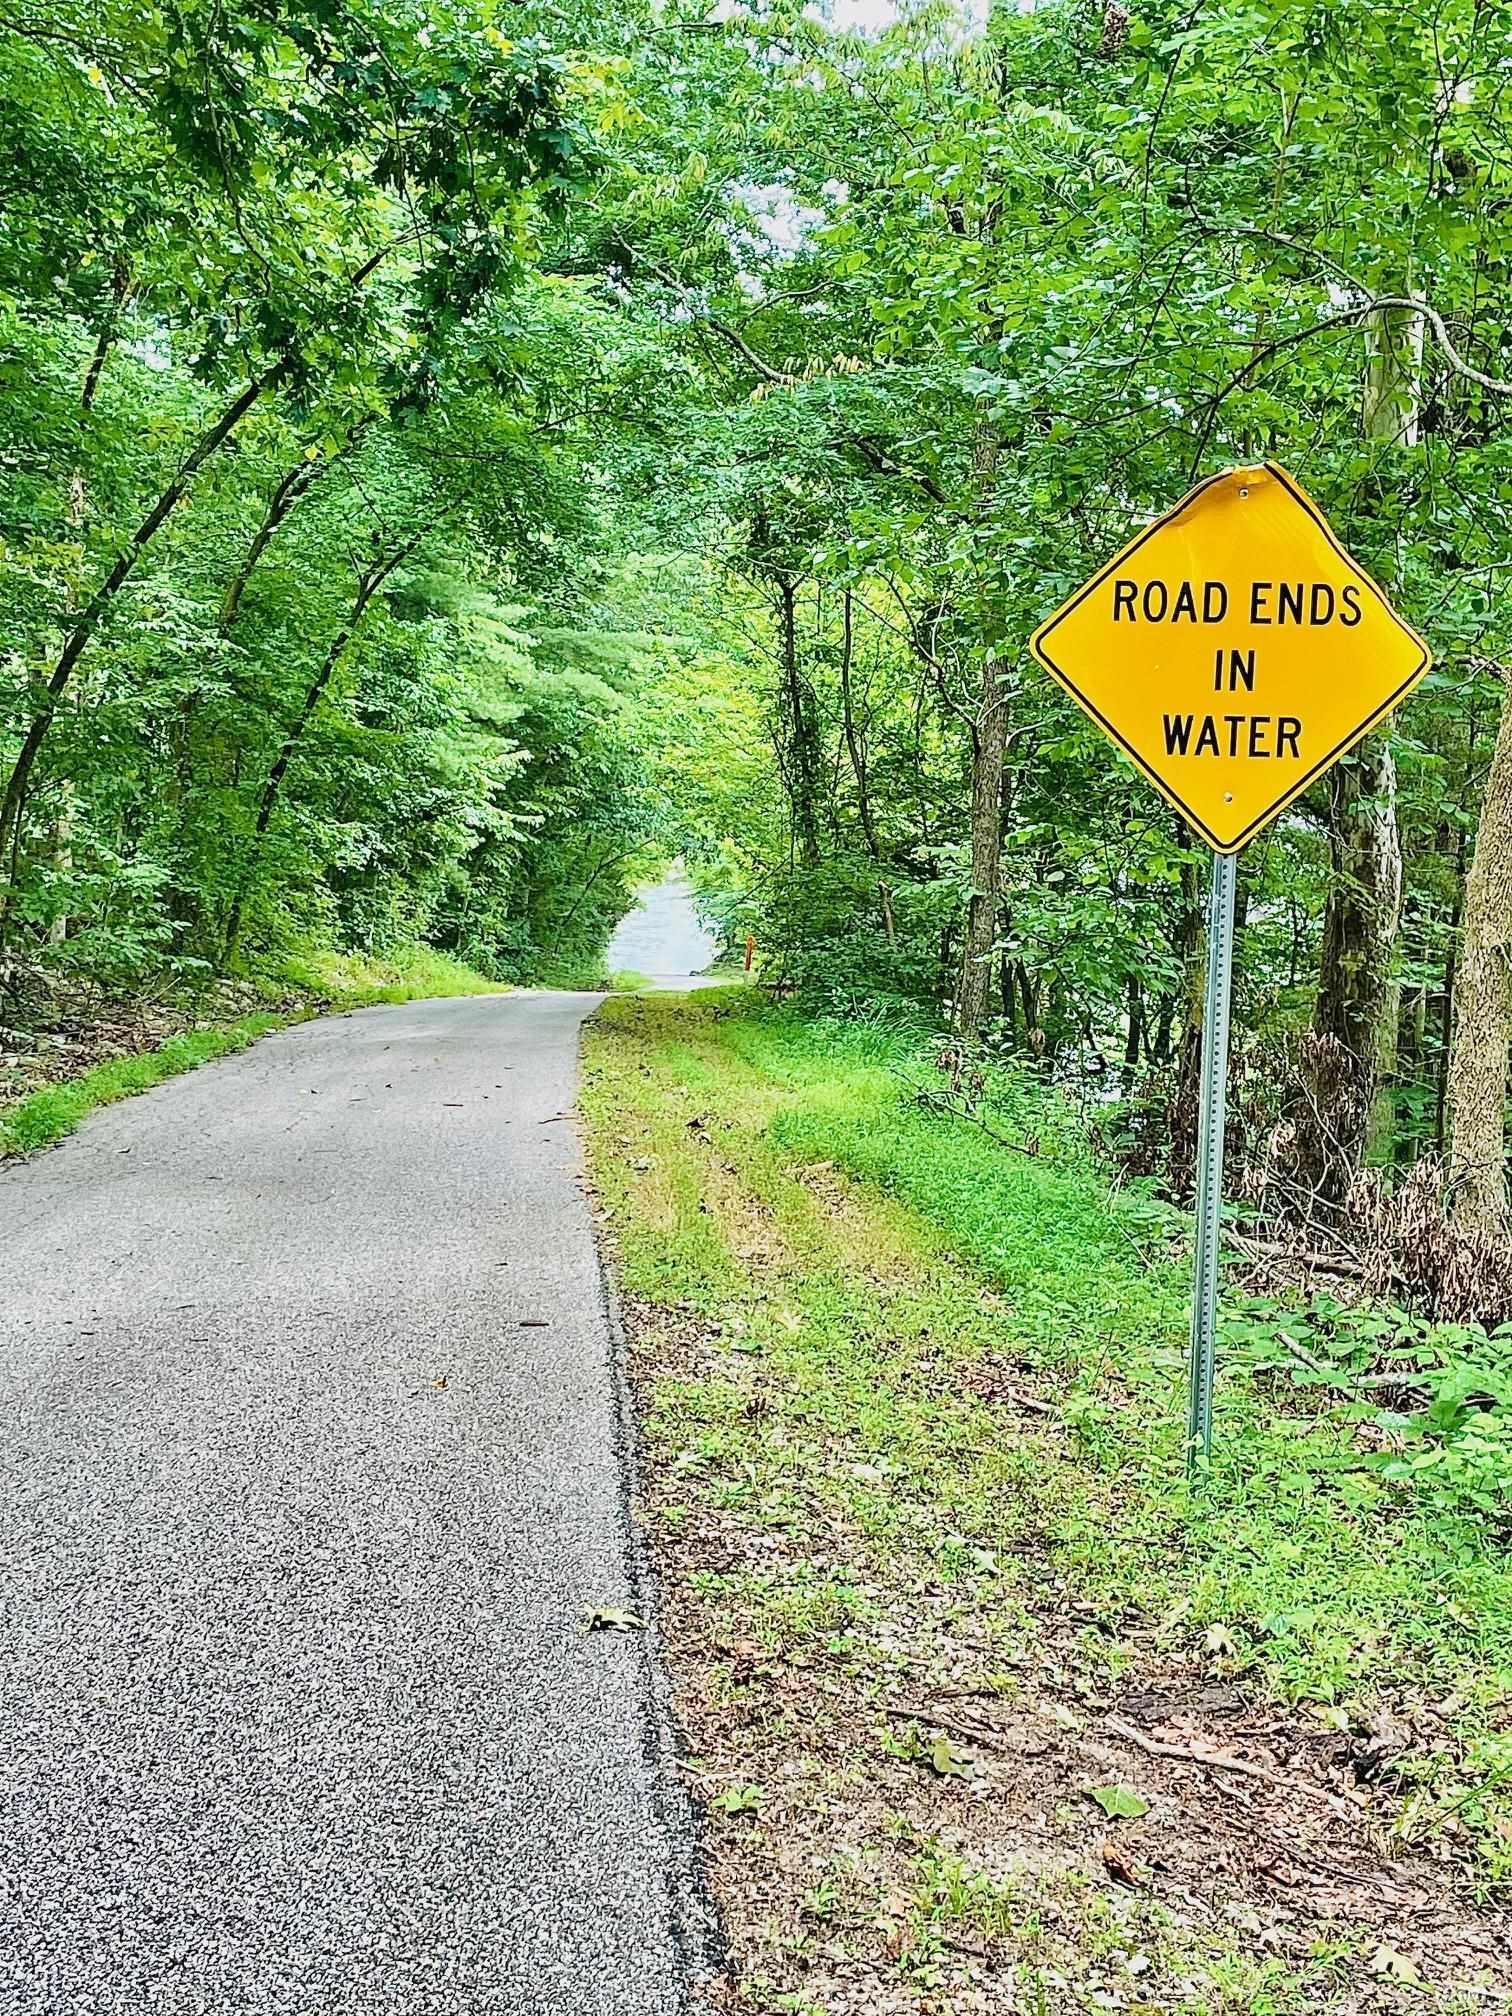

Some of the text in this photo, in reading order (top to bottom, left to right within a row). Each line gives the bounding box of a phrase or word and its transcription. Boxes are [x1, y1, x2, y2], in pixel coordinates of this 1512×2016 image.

[1114, 581, 1362, 626] ROAD ENDS
[1215, 650, 1255, 691] IN
[1164, 715, 1301, 758] WATER
